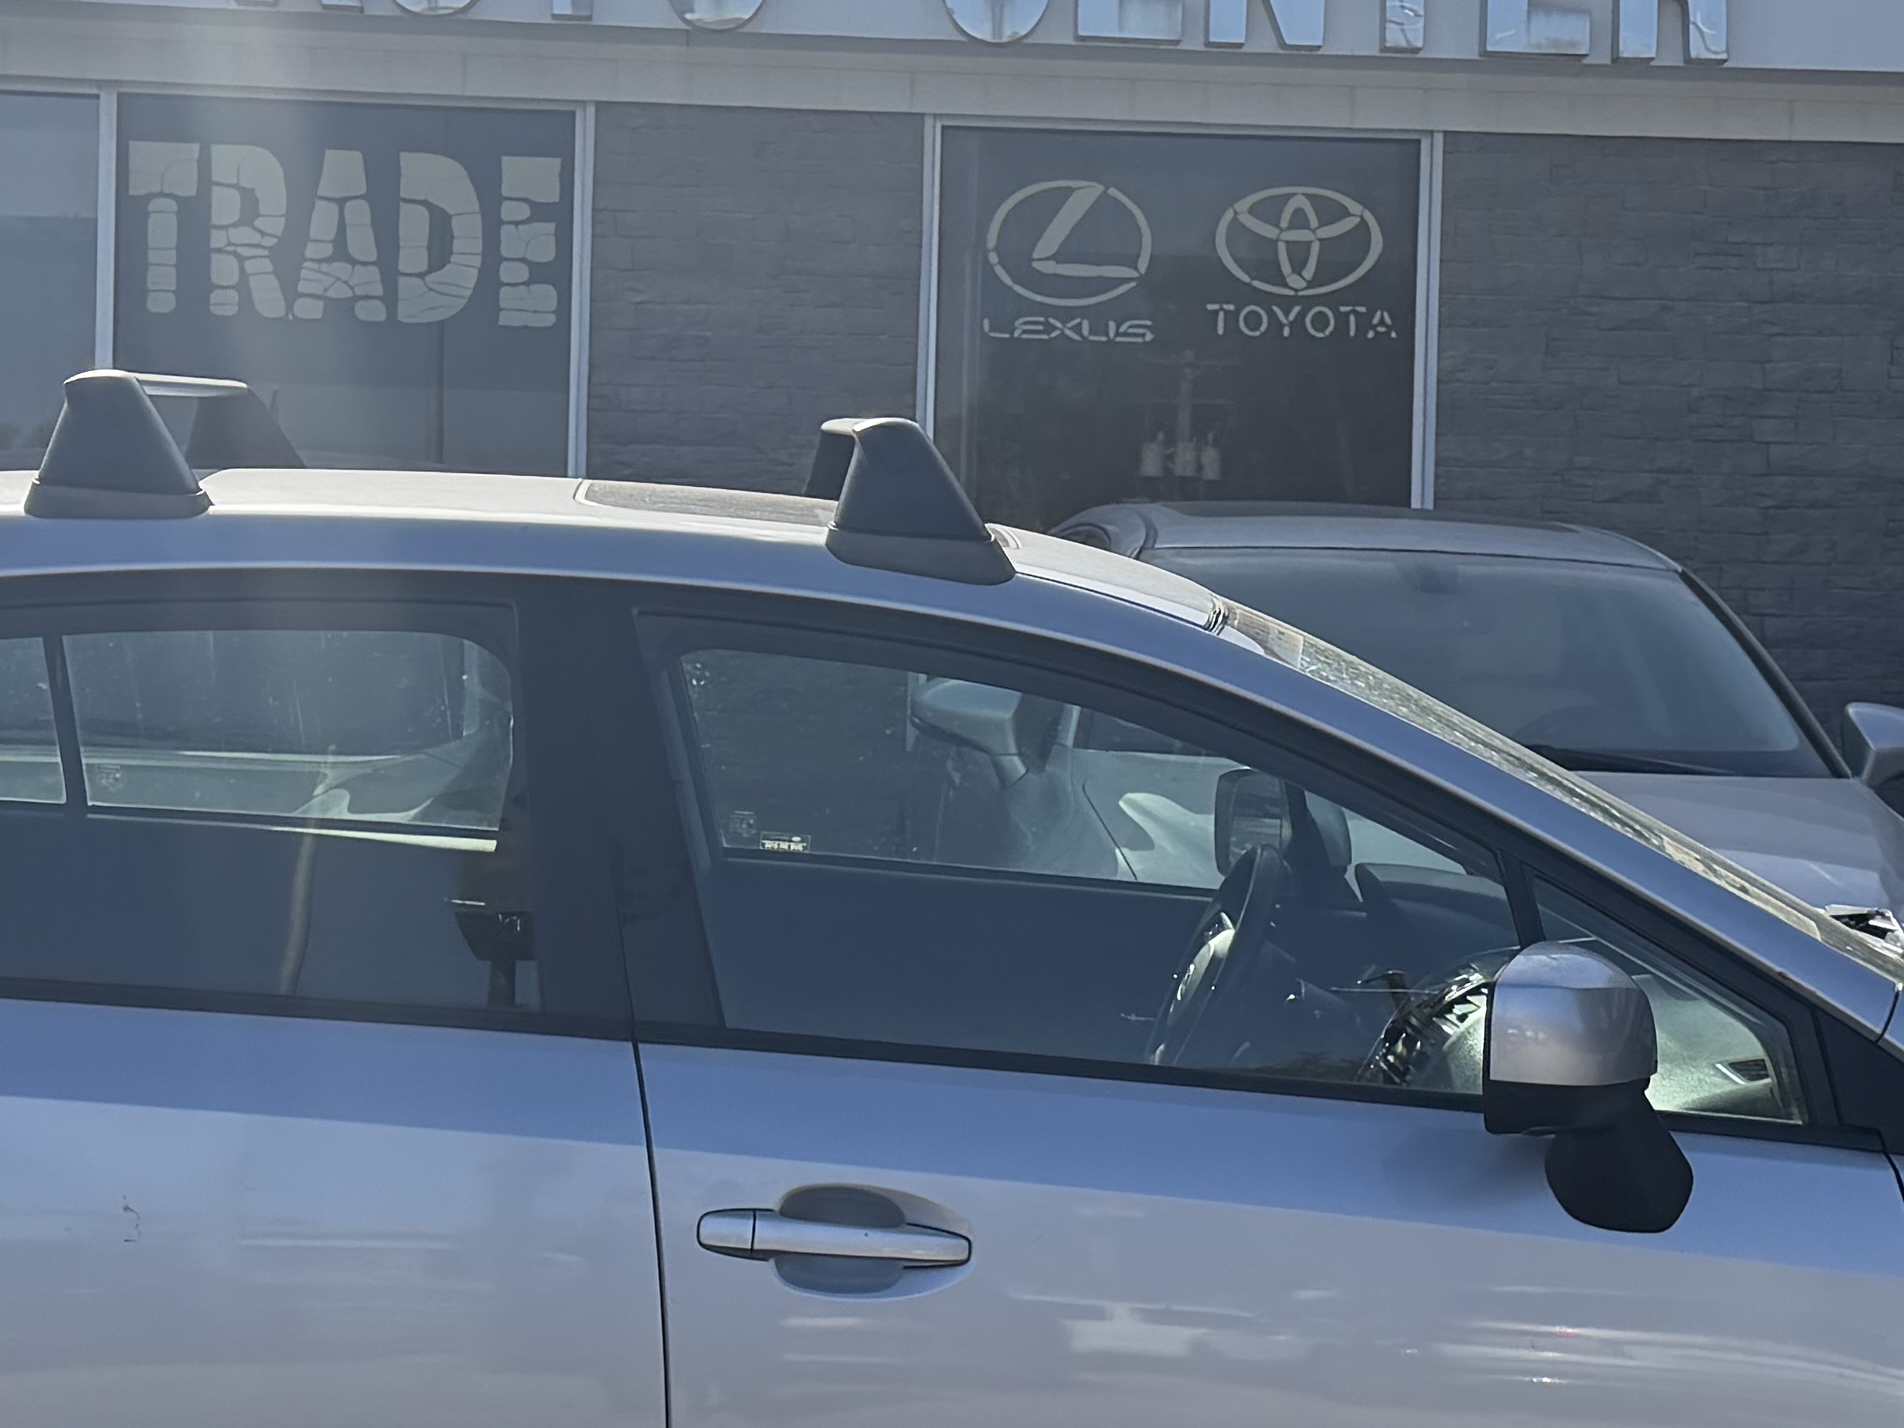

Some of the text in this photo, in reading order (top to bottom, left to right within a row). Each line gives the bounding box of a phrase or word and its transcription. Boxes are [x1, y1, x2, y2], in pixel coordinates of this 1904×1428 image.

[128, 140, 562, 328] TRADE
[983, 316, 1155, 343] LEXUS
[1206, 303, 1397, 339] TOYOTA
